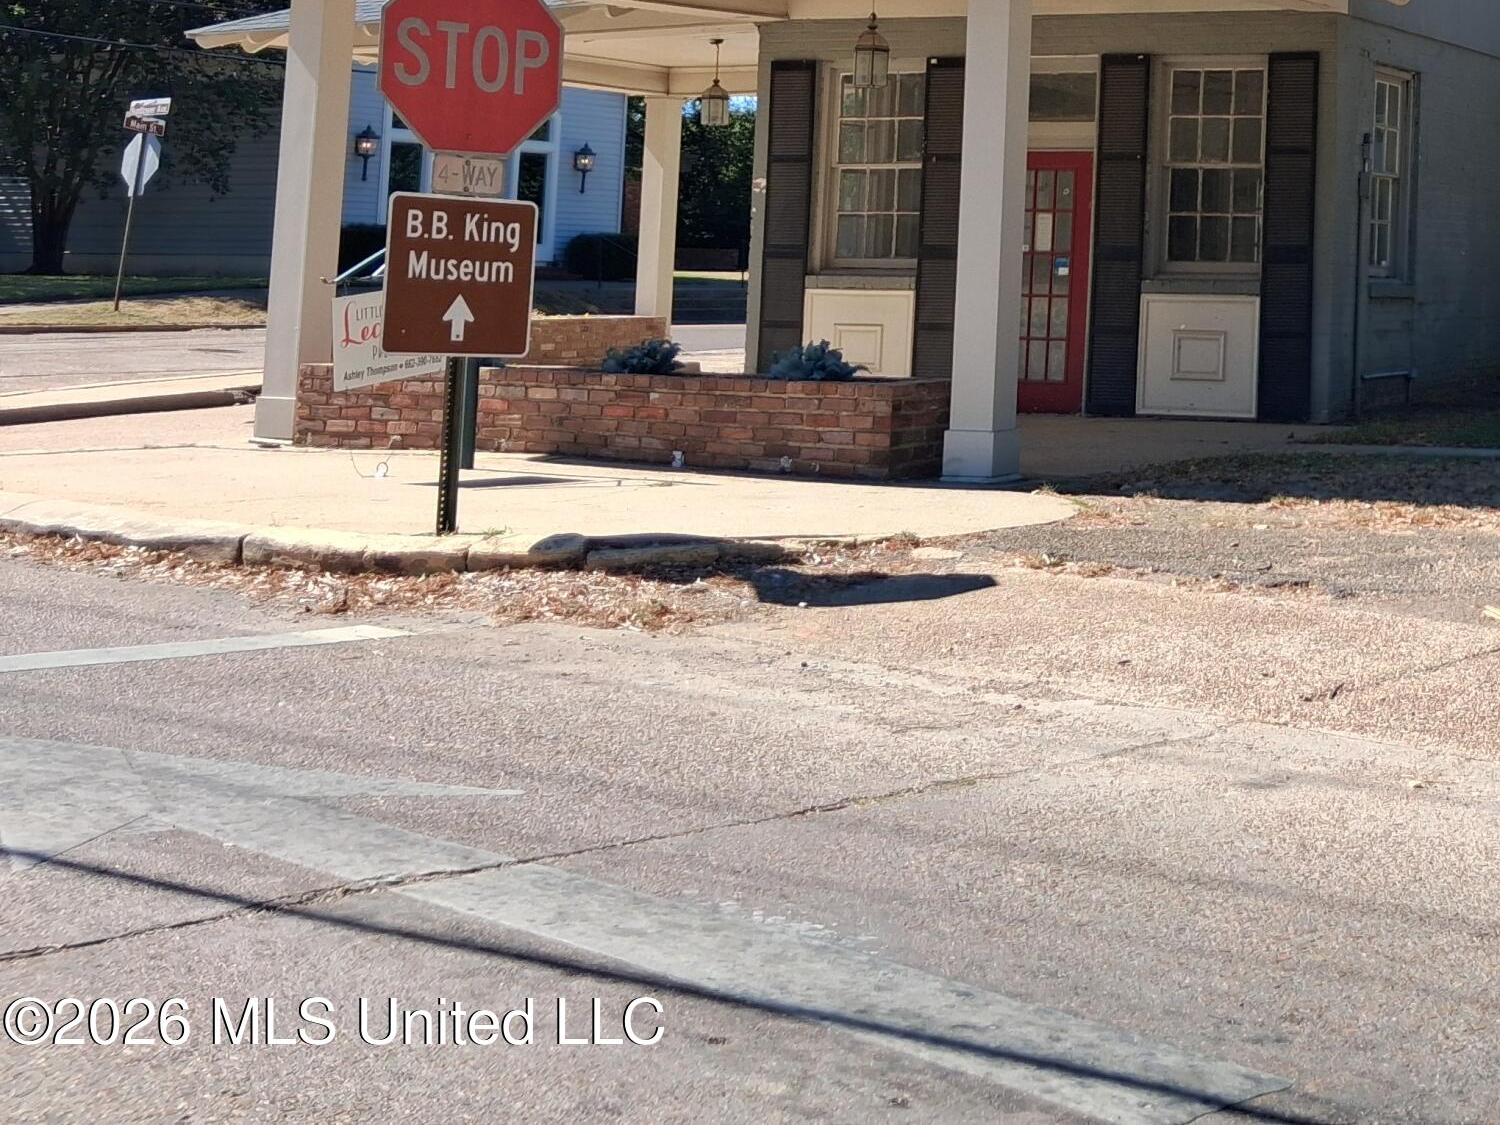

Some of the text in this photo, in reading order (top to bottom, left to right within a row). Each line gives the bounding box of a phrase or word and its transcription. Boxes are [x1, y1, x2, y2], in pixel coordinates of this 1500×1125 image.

[393, 16, 550, 95] STOP
[130, 119, 147, 131] Main
[438, 164, 498, 187] 4-WAY
[406, 209, 521, 253] B.B. King
[407, 249, 514, 283] Museum
[343, 370, 365, 381] Ashley
[366, 363, 398, 377] Thompson
